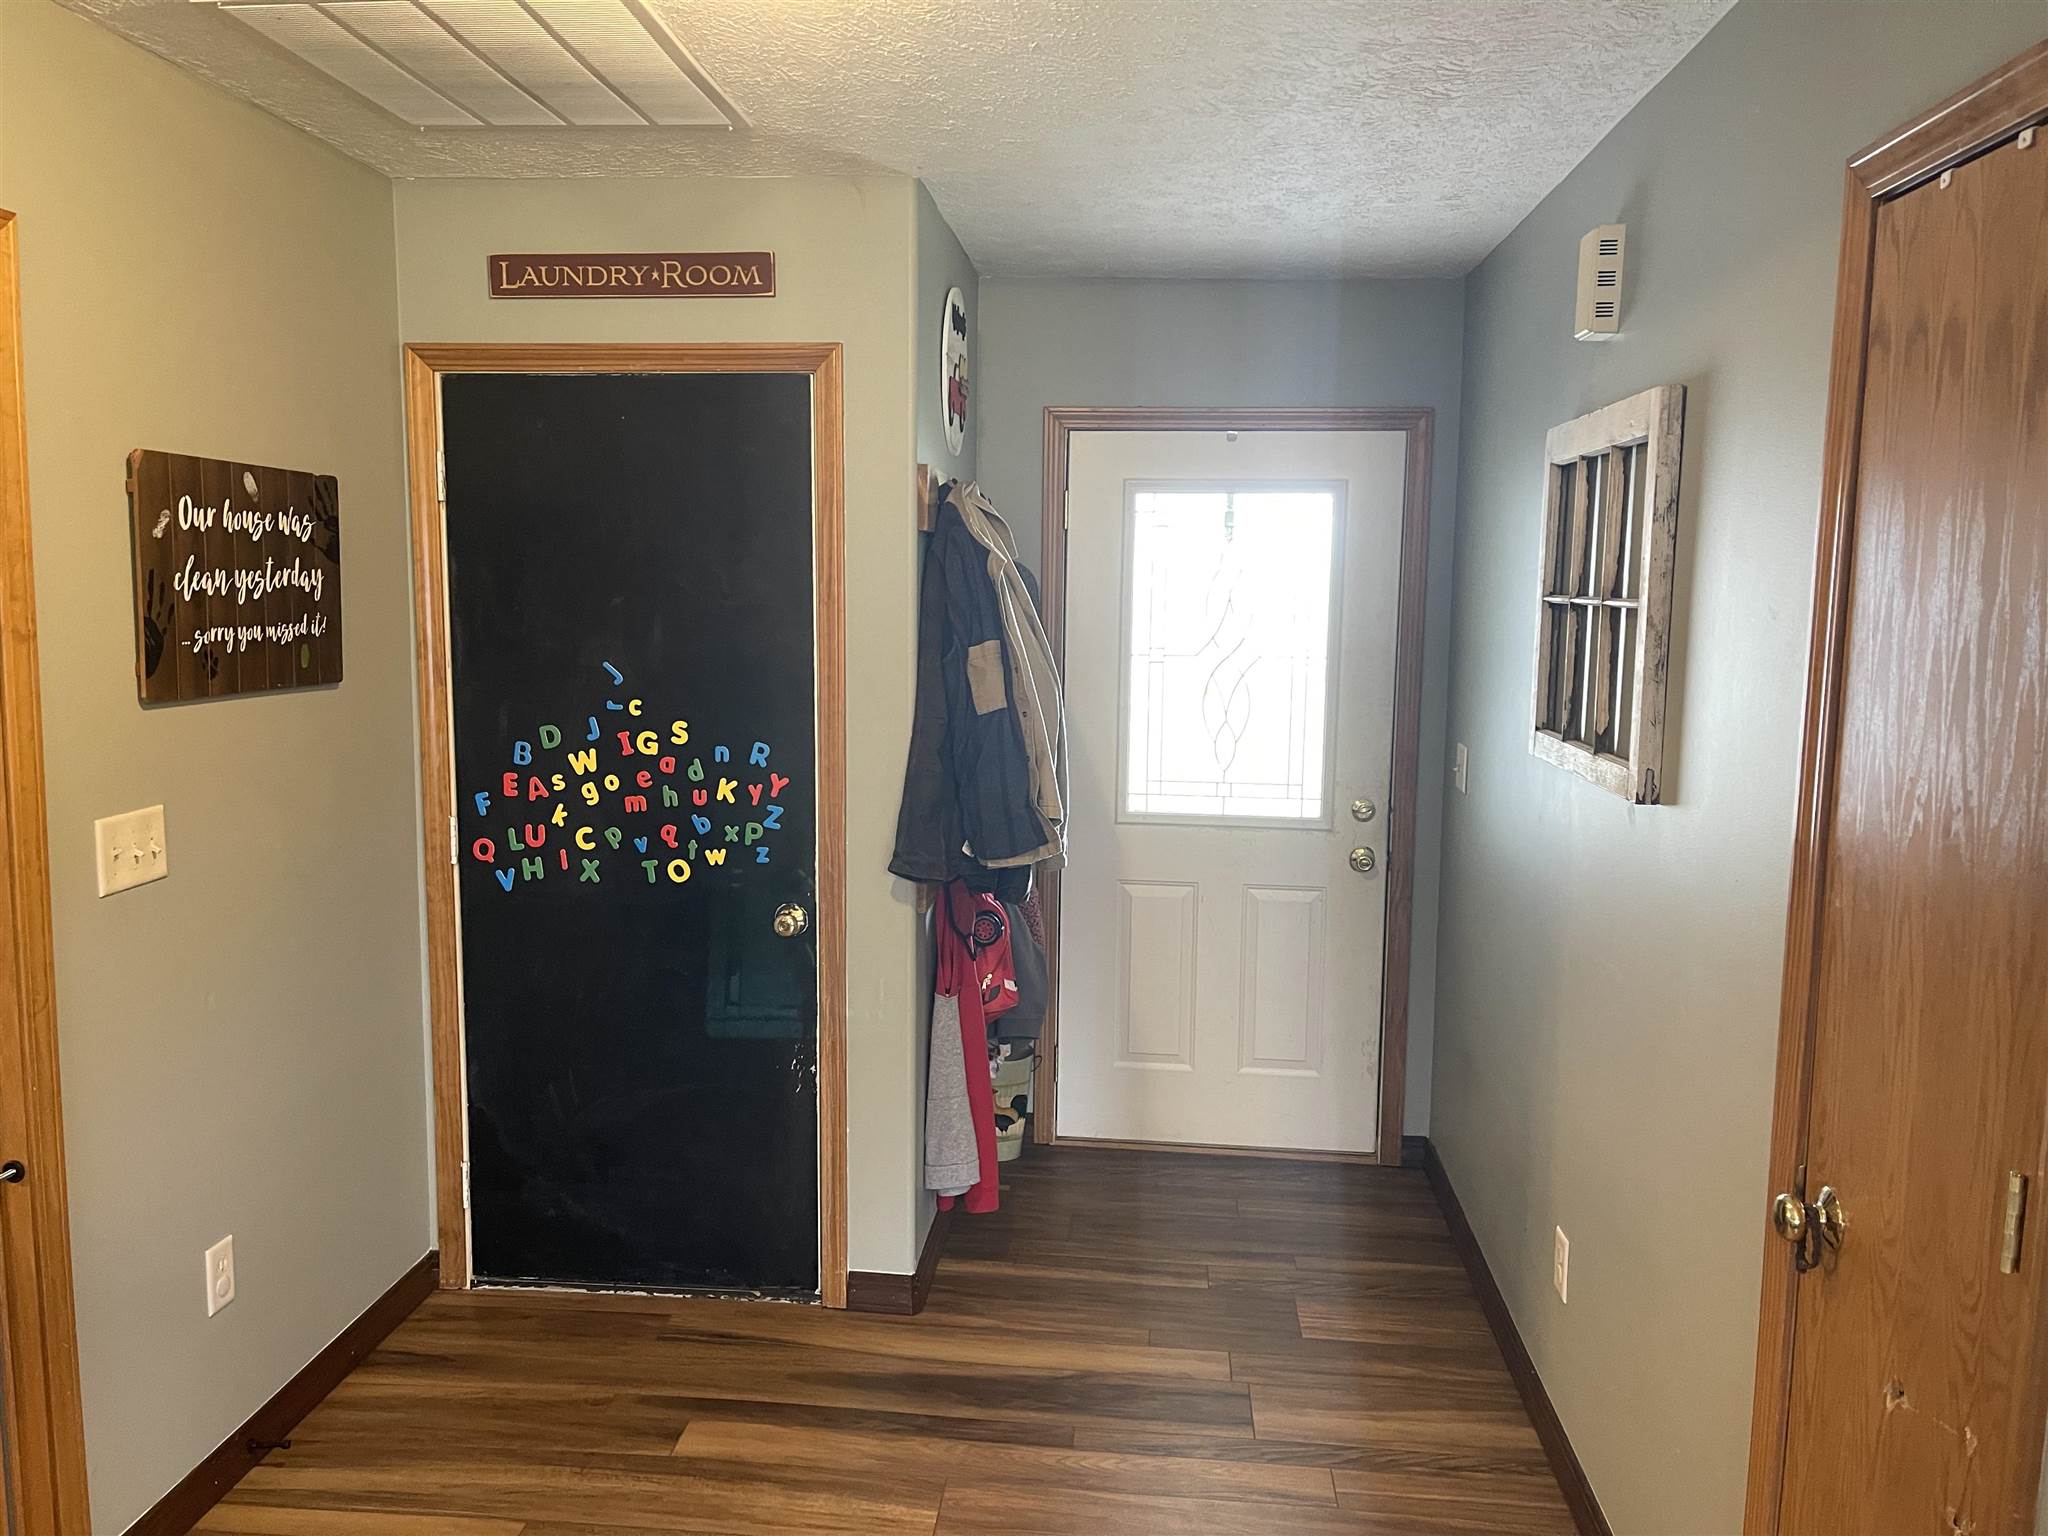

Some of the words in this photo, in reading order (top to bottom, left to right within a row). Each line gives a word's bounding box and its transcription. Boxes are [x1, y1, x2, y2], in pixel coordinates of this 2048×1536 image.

[178, 495, 216, 532] Our
[222, 498, 275, 541] house
[278, 506, 317, 542] was
[173, 554, 233, 601] clean
[234, 556, 324, 605] yesterday
[237, 625, 264, 652] you
[265, 613, 308, 645] missed
[311, 612, 327, 637] it!
[538, 724, 562, 749] D
[635, 730, 659, 756] G
[513, 740, 533, 766] B
[659, 755, 676, 775] a
[749, 741, 771, 768] R
[636, 770, 653, 789] e
[687, 758, 705, 782] d
[502, 771, 519, 797] E
[528, 775, 550, 802] A
[580, 781, 600, 806] g
[662, 784, 679, 808] h
[474, 791, 491, 817] F
[472, 837, 496, 864] Q
[507, 827, 525, 851] L
[521, 856, 545, 881] H
